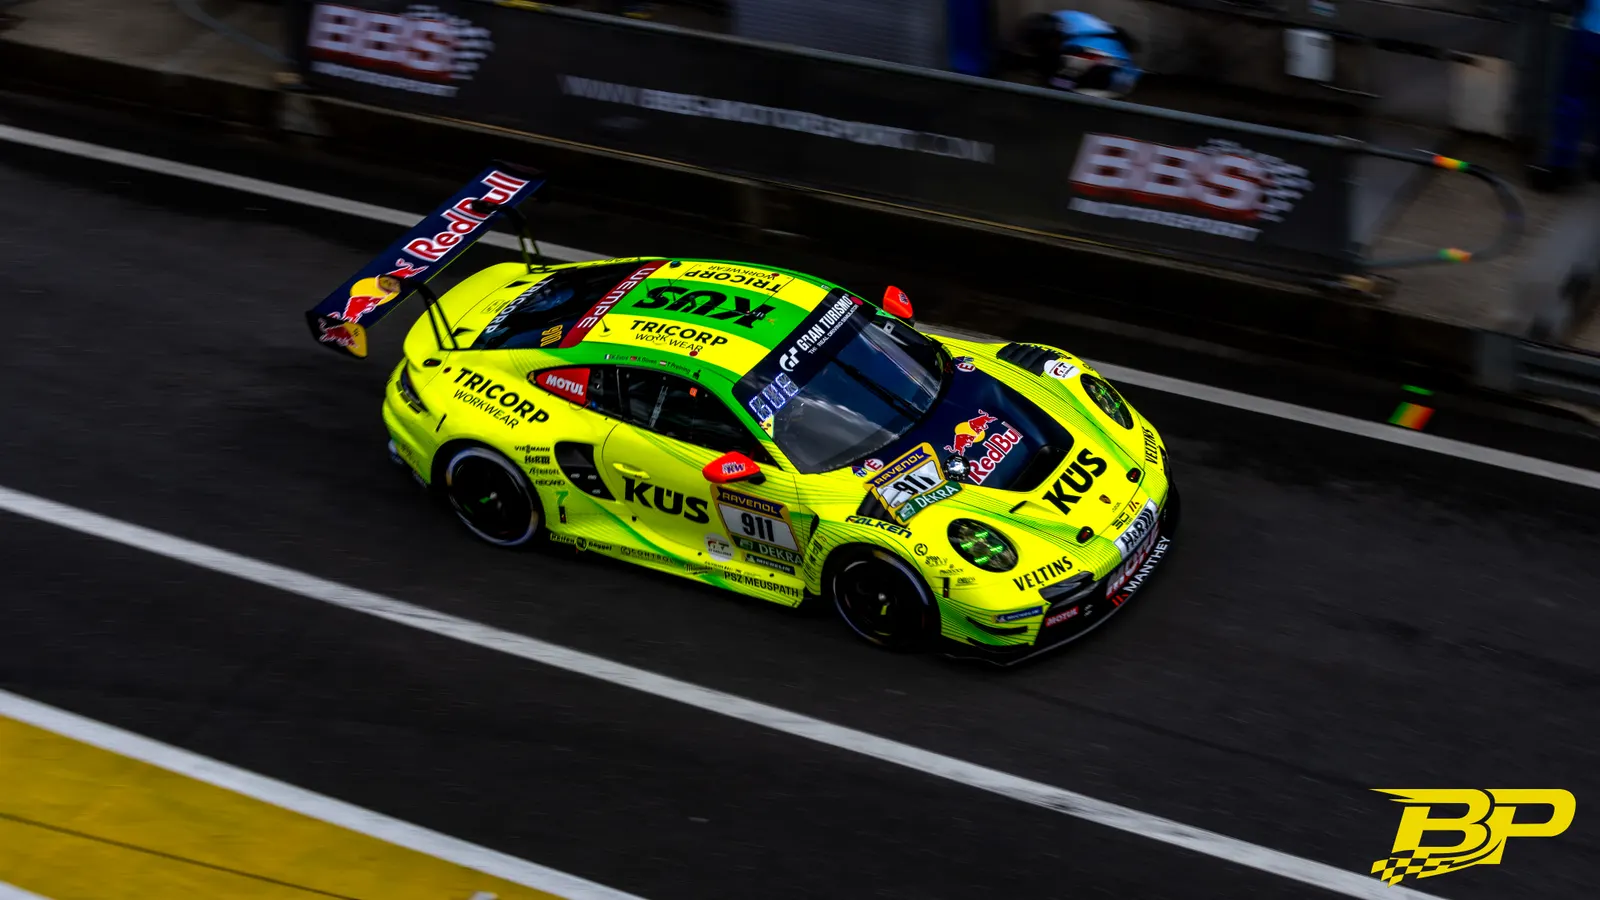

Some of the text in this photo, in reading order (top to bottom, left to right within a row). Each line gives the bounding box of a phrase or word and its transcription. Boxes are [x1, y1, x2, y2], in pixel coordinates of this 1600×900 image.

[307, 3, 455, 77] BBS
[1069, 133, 1261, 216] BBS
[577, 267, 656, 329] WEMPE
[685, 270, 782, 293] TRICORP
[485, 278, 554, 334] TRICORP
[796, 293, 854, 352] GRAN TURISMO
[630, 320, 728, 346] TRICORP
[453, 368, 549, 423] TRICORP
[546, 374, 585, 396] MOTUL
[453, 389, 519, 429] WORKWEAR
[1142, 426, 1158, 465] VELTINS
[873, 453, 924, 486] RAVENOL
[1042, 448, 1107, 515] KÜS
[622, 476, 710, 524] KÜS
[721, 491, 778, 515] RAVENOL
[915, 483, 959, 508] DEKRA
[741, 512, 775, 542] 911
[845, 515, 912, 539] FALKEN
[758, 543, 802, 565] DEKRA
[1123, 535, 1171, 593] MANTHEY
[723, 571, 744, 584] PSZ
[745, 575, 799, 598] MEUSPATH
[1012, 555, 1073, 592] VELTINS
